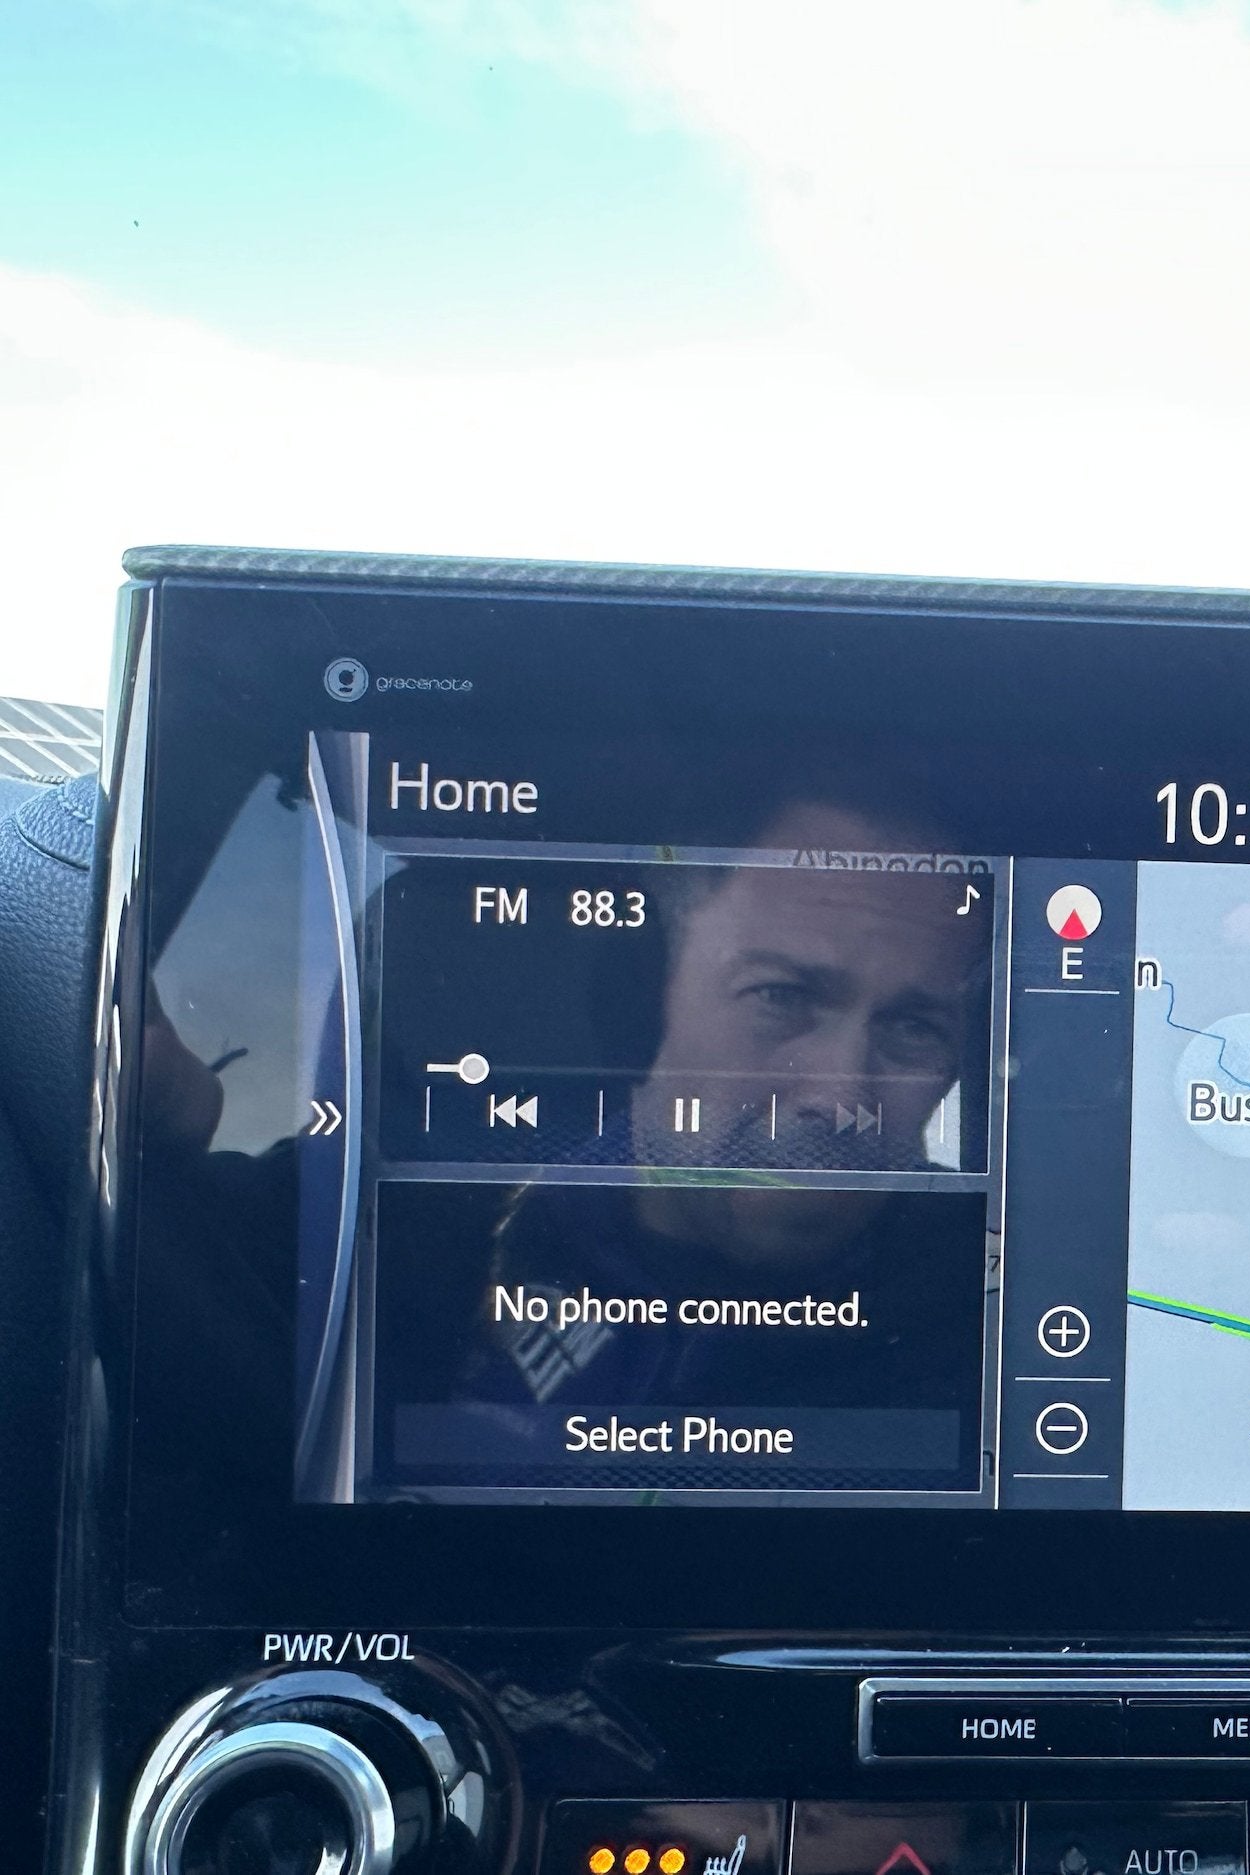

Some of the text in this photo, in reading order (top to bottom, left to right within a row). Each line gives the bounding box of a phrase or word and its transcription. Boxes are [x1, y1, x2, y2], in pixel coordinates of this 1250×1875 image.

[391, 762, 537, 813] Home
[476, 887, 645, 927] FM 88.3
[1062, 948, 1083, 979] E
[496, 1286, 867, 1330] No phone connected.
[566, 1416, 793, 1453] Select Phone
[264, 1632, 414, 1664] PWR/VOL
[963, 1719, 1035, 1739] HOME
[1125, 1850, 1198, 1875] AUTO
